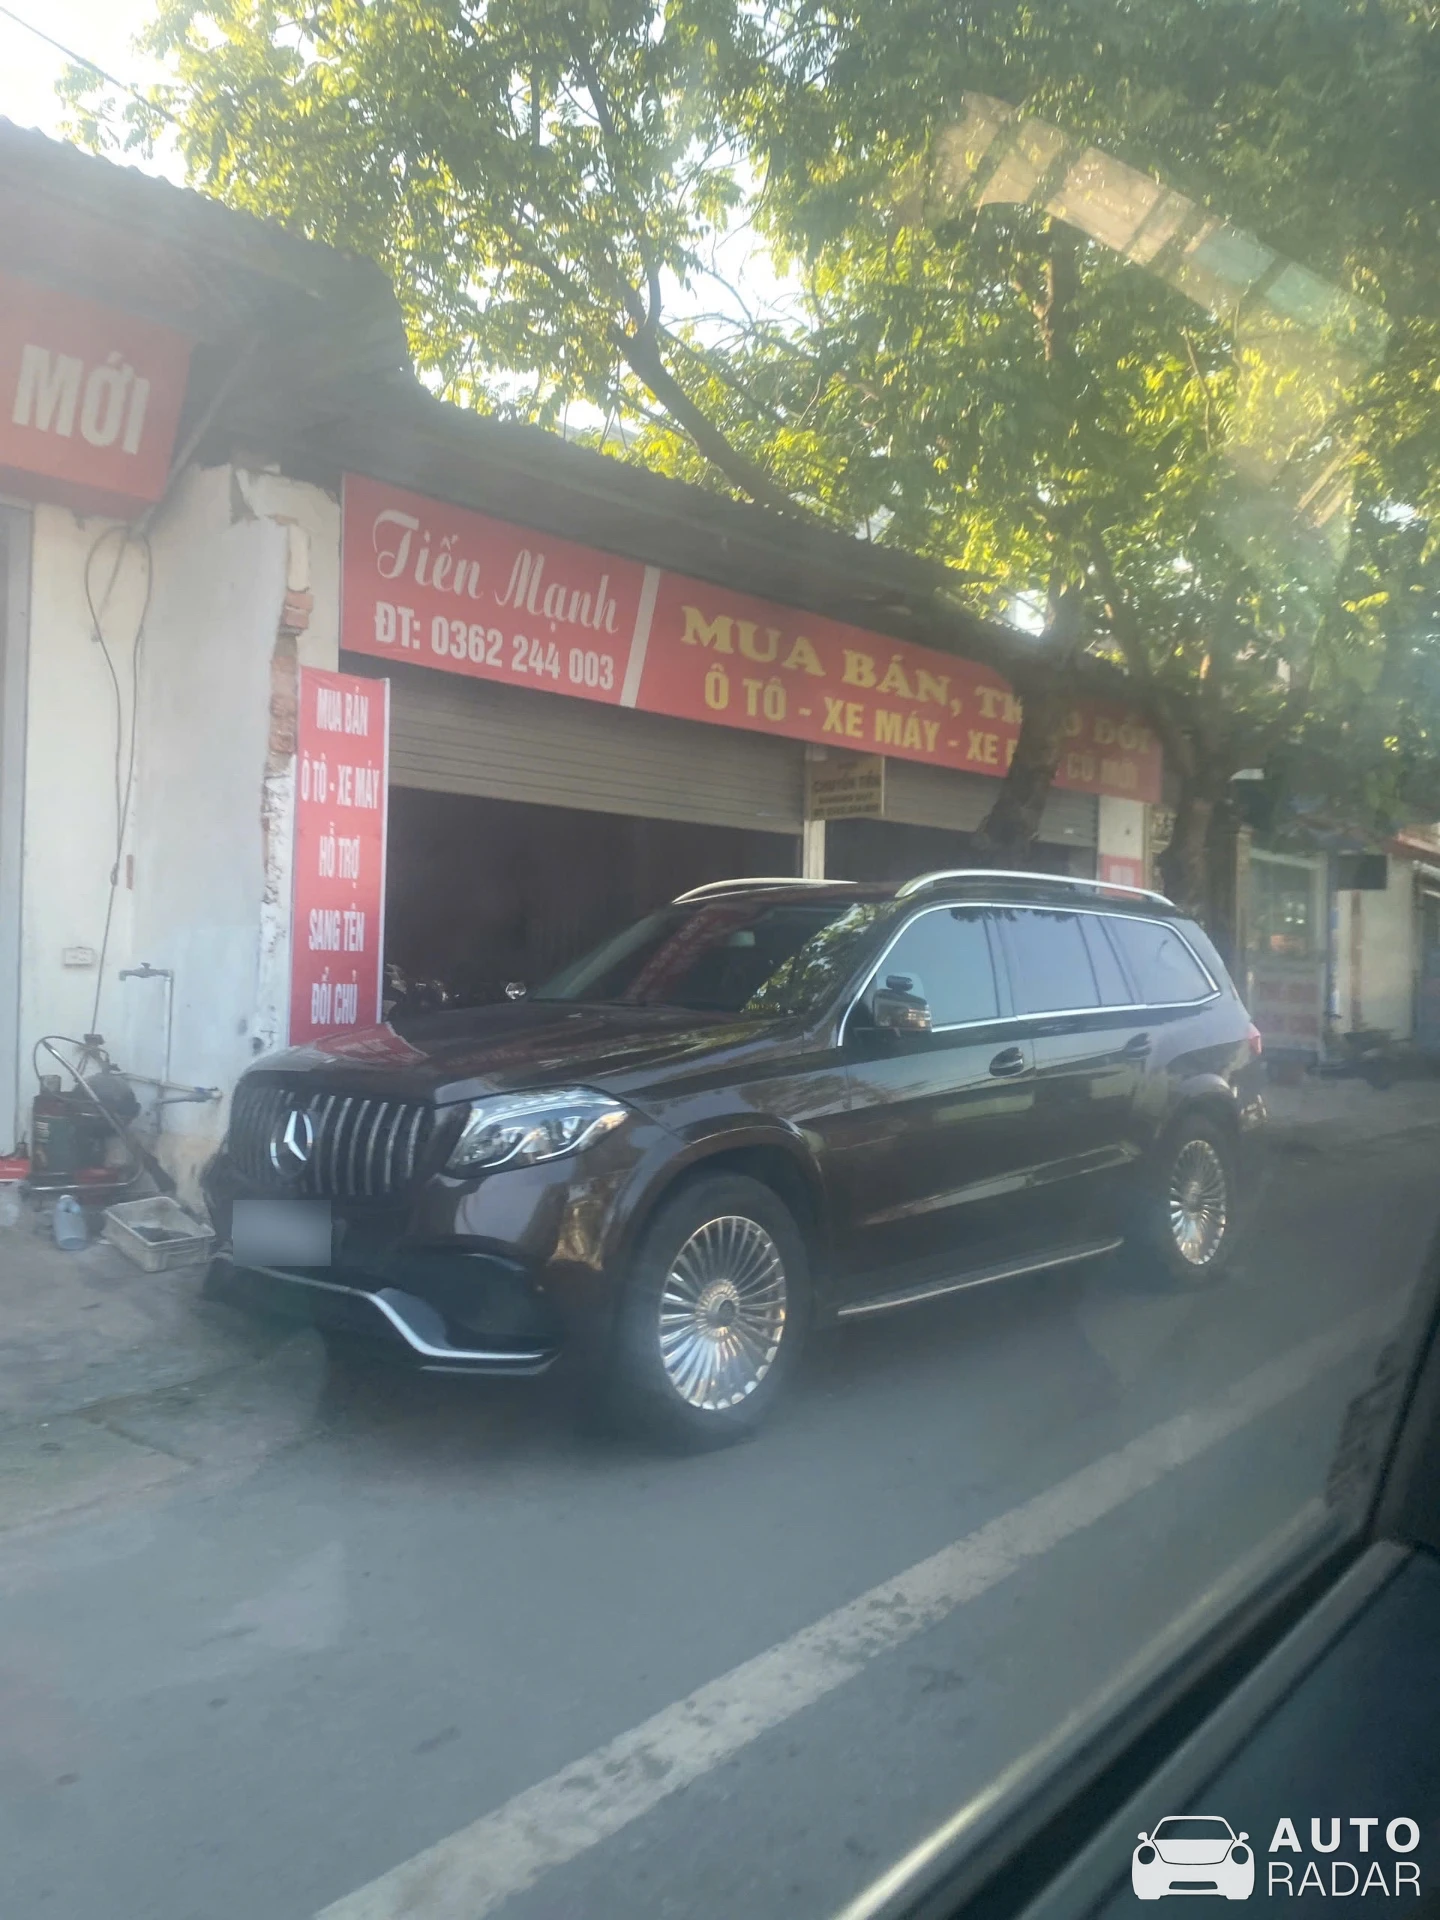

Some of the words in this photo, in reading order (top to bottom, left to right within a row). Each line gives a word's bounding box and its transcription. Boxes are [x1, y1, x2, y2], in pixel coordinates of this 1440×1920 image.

[12, 343, 150, 455] MỚI
[372, 509, 483, 599] Tiến
[495, 549, 618, 633] Mạnh
[374, 601, 421, 649] ĐT:
[431, 615, 502, 667] 0362
[512, 635, 560, 680] 244
[568, 648, 614, 690] 003
[680, 605, 827, 677] MUA
[841, 650, 962, 717] BÁN,
[317, 688, 342, 732] MUA
[345, 686, 368, 736] BÁN
[705, 662, 729, 710] Ô
[742, 676, 787, 721] TÔ
[822, 696, 864, 738] XE
[875, 710, 940, 752] MÁY
[966, 729, 999, 765] XE
[313, 752, 327, 803] TÔ
[337, 765, 353, 806] XE
[355, 760, 379, 809] MÁY
[338, 835, 360, 888] TRỢ
[309, 908, 341, 951] SANG
[343, 903, 365, 951] TÊN
[311, 966, 332, 1024] ĐỔI
[335, 969, 357, 1024] CHỦ
